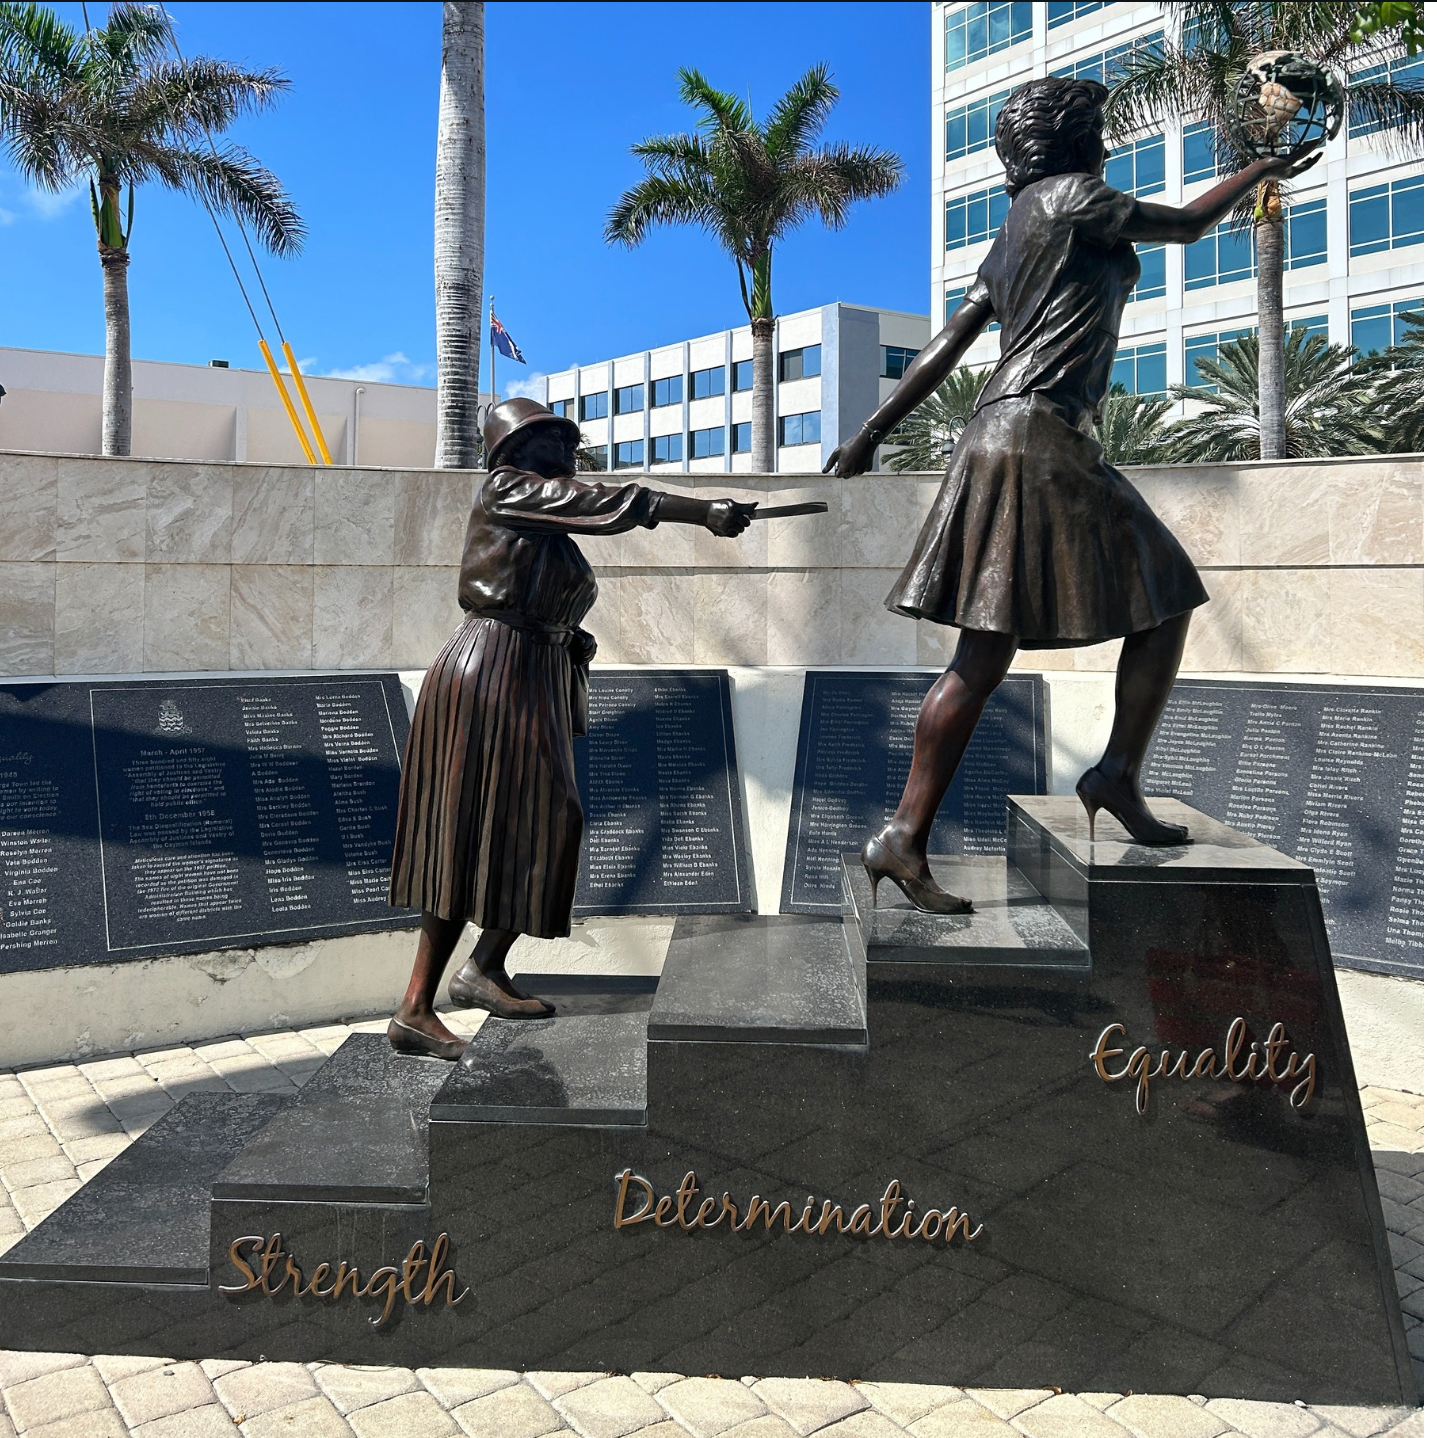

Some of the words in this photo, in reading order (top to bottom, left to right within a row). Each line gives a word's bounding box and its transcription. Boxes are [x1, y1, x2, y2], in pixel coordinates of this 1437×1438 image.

[160, 811, 196, 820] December
[1089, 1017, 1316, 1116] Equality
[614, 1168, 984, 1242] Determination
[218, 1232, 470, 1327] Strength
